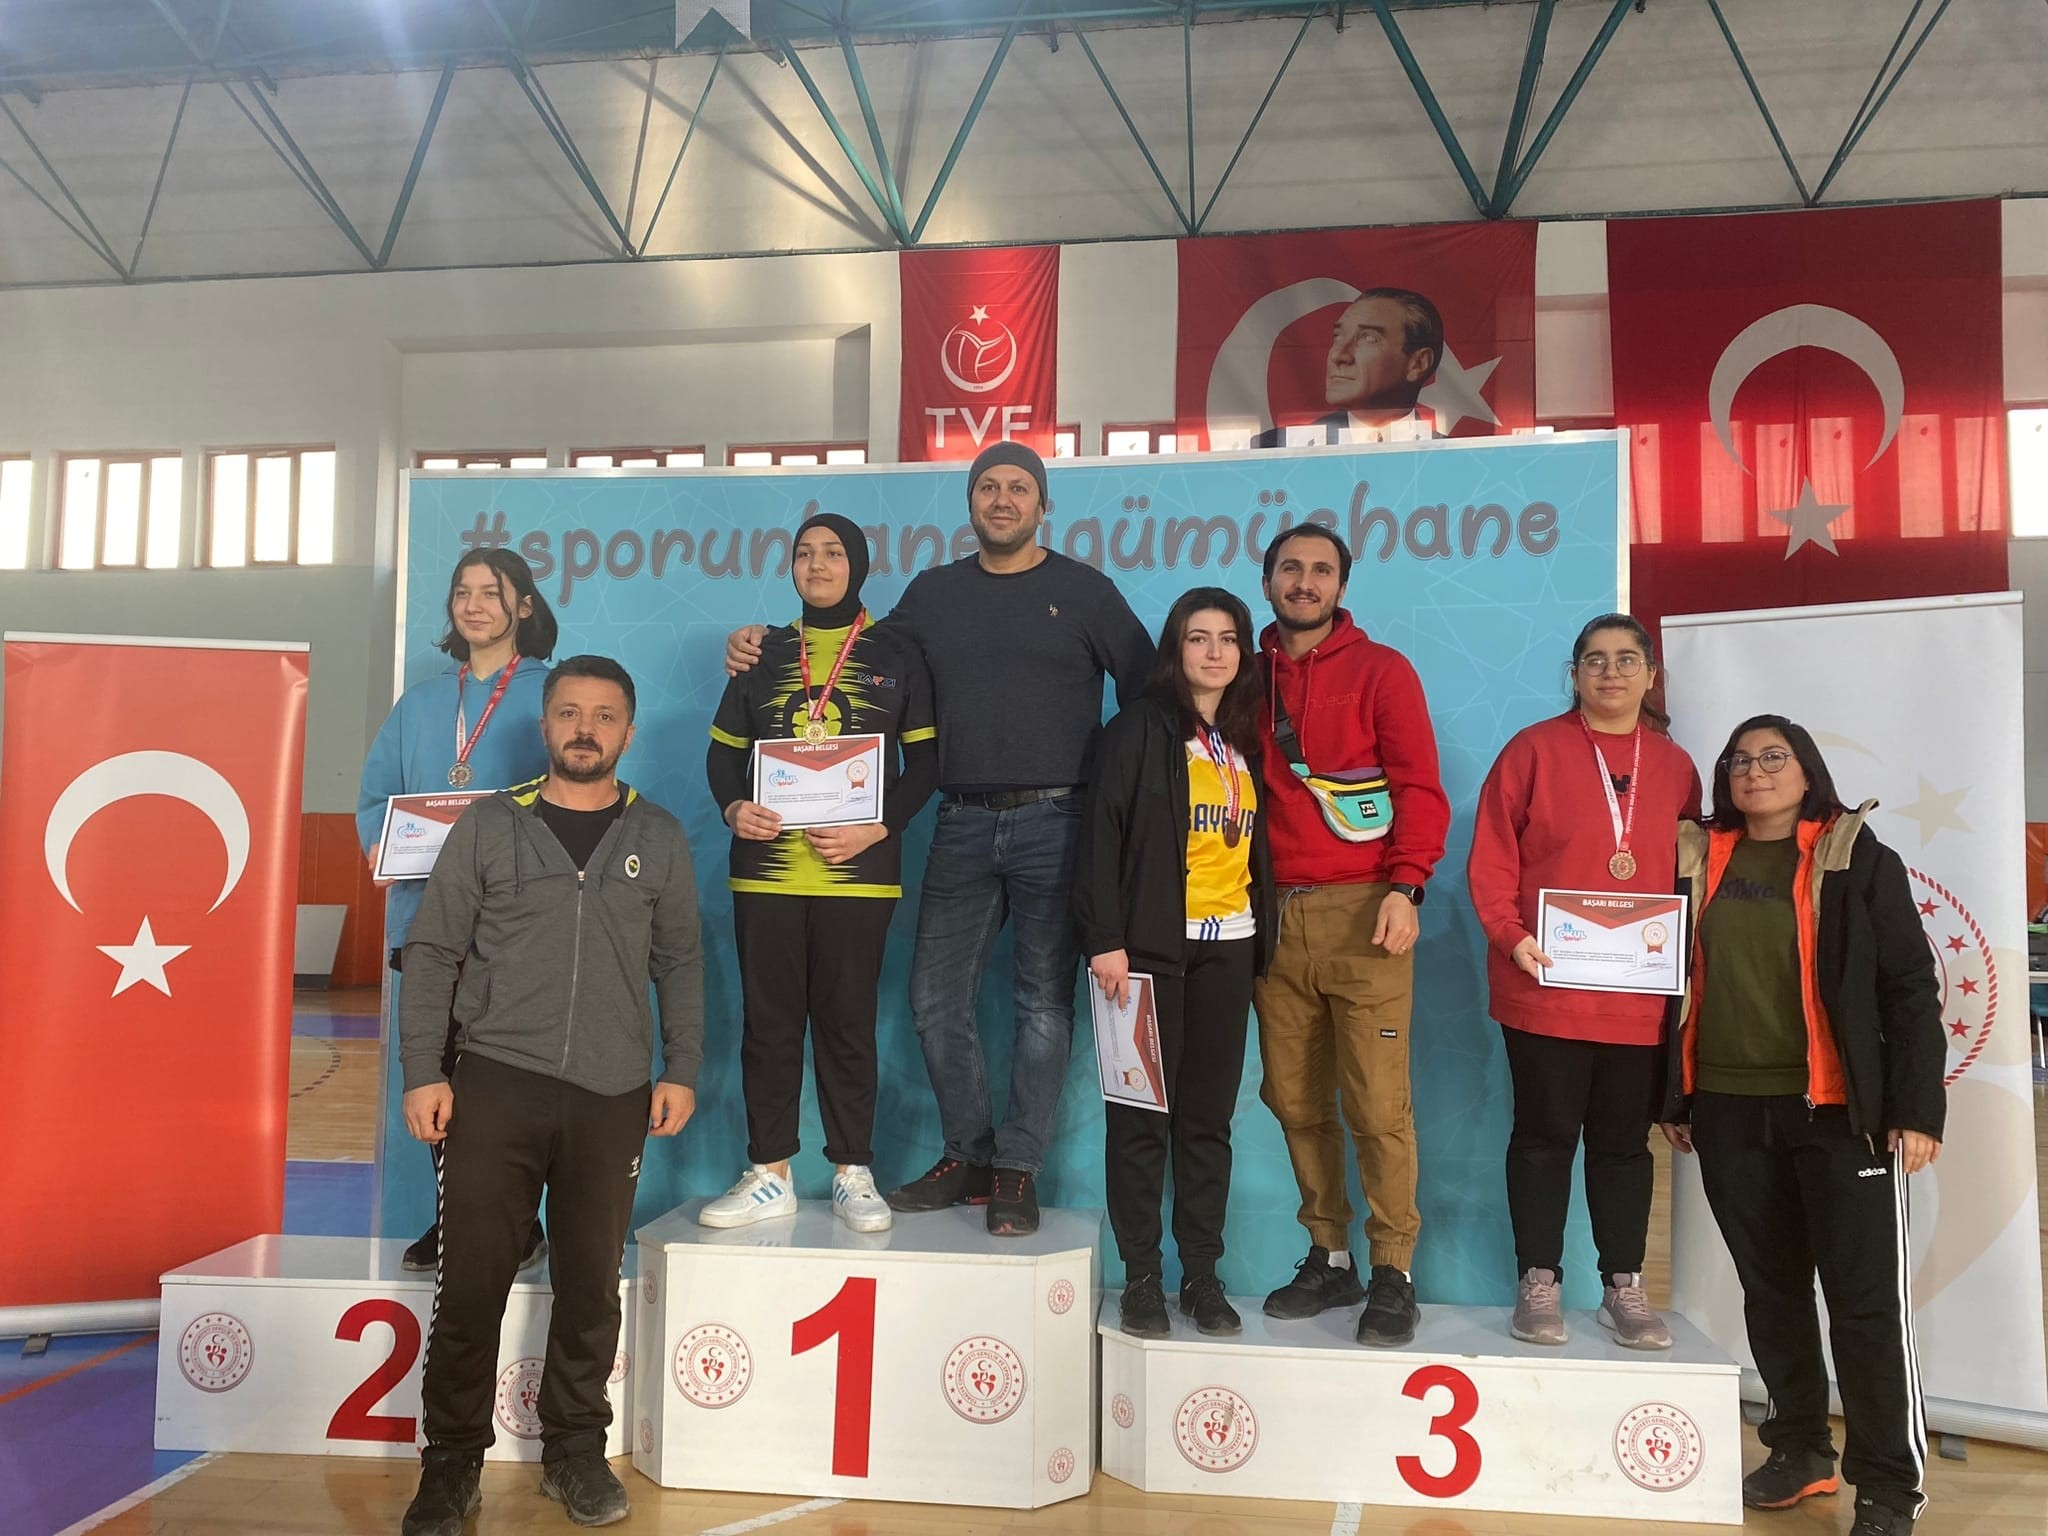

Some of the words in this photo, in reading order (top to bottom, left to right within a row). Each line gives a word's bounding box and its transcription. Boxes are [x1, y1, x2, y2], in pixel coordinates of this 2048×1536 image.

[925, 405, 1032, 448] TVF
[1582, 899, 1606, 908] BAŞARI
[1608, 900, 1634, 908] BELGESİ
[326, 1299, 419, 1443] 2
[791, 1276, 877, 1478] 1
[1396, 1365, 1481, 1498] 3
